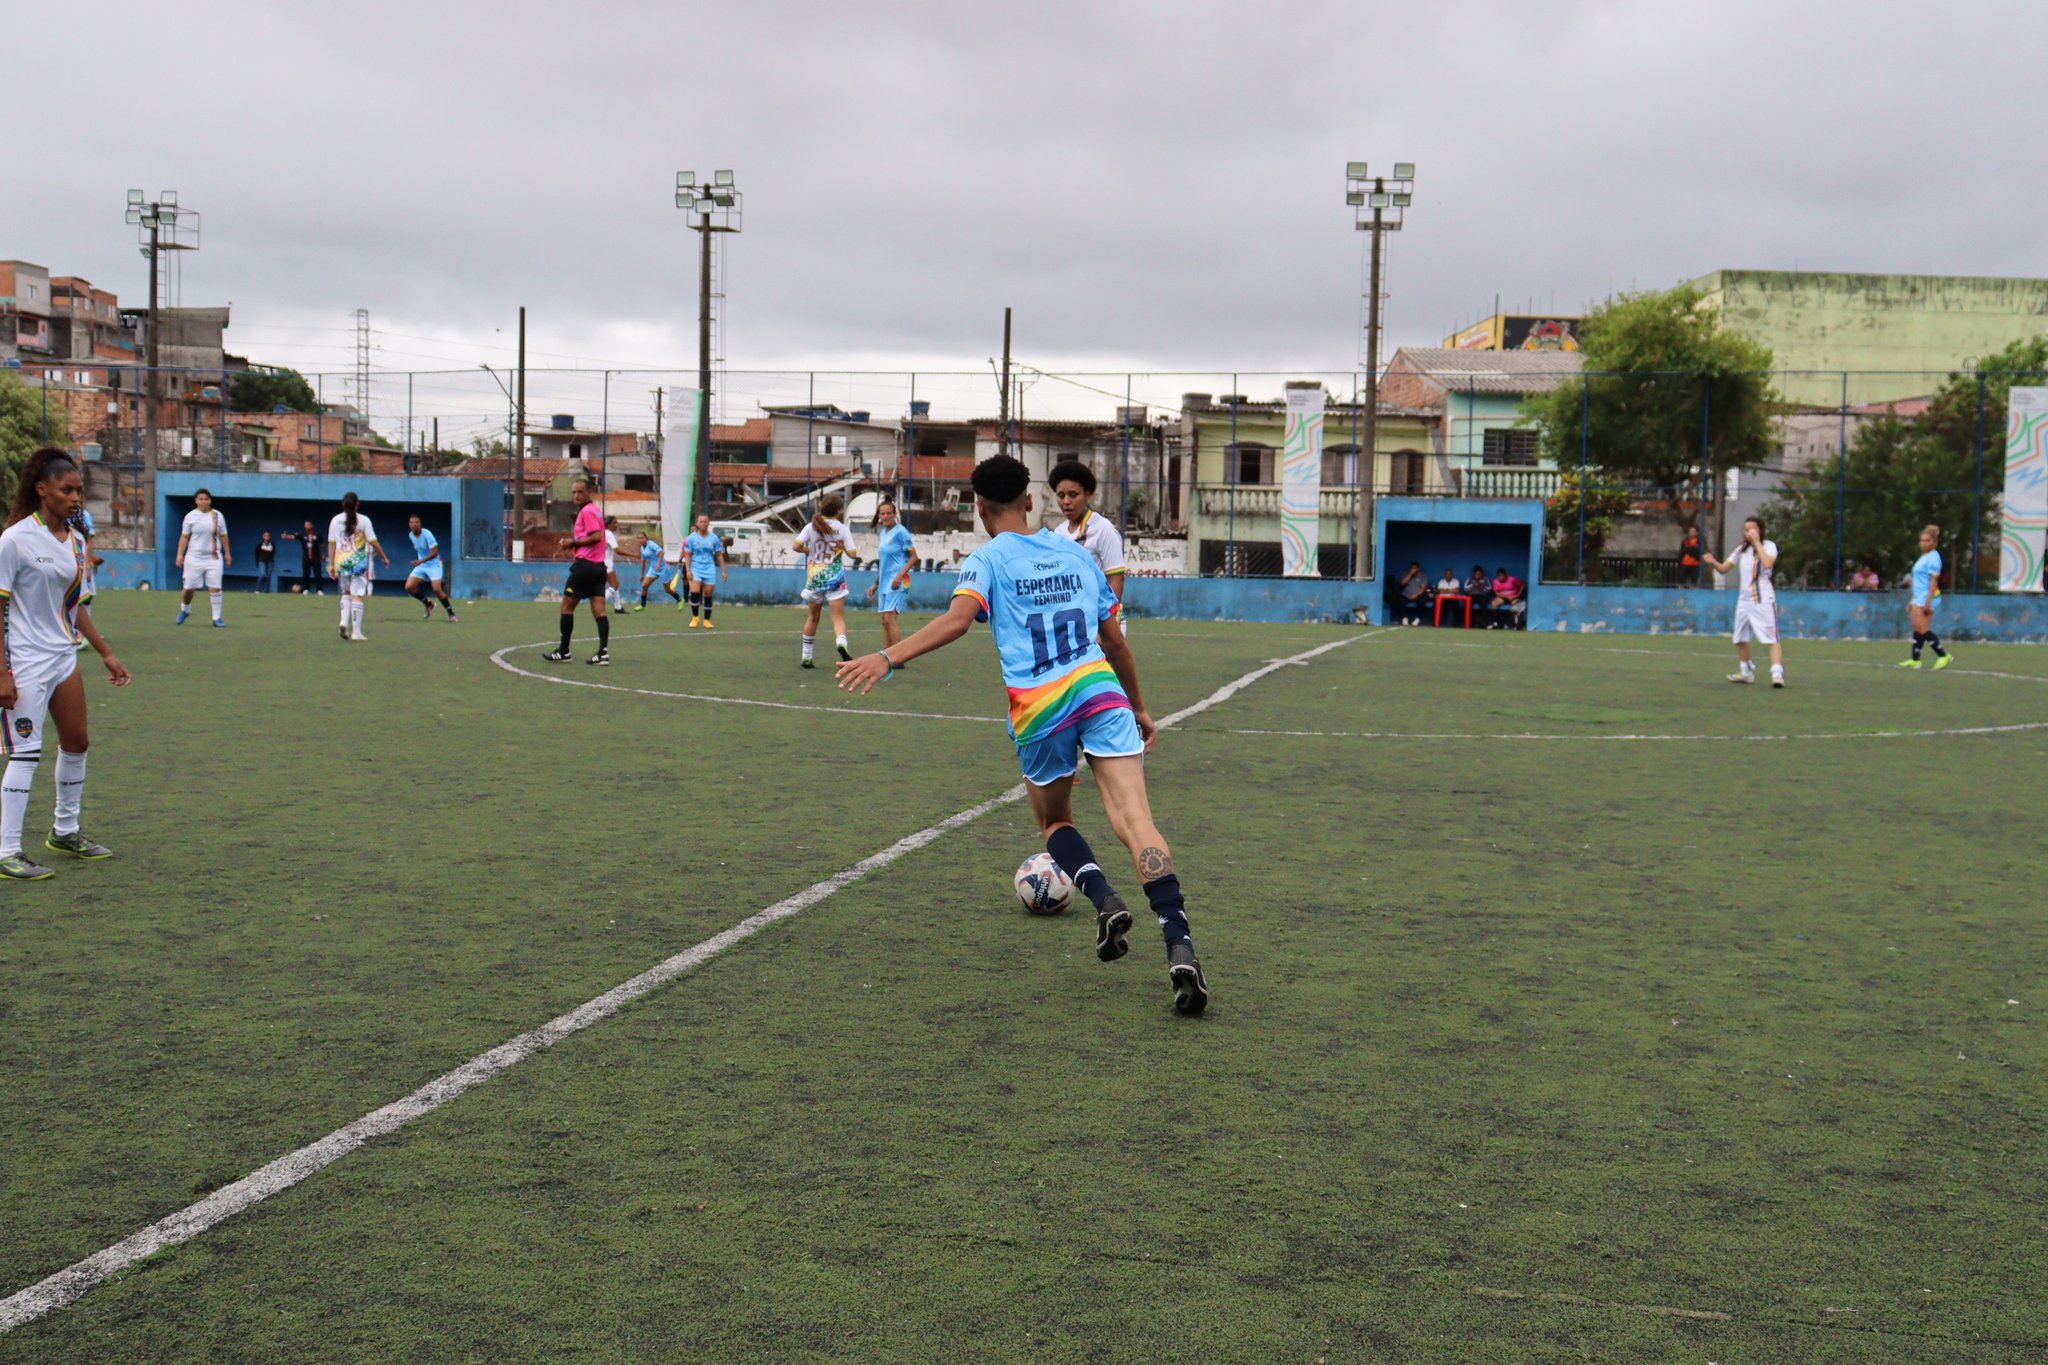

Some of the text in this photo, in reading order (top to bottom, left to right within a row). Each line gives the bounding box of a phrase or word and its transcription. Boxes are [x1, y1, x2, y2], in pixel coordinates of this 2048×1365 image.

[1015, 574, 1083, 596] ESPERANÇA
[1034, 592, 1072, 606] FEMININO
[1024, 608, 1091, 678] 10
[1034, 876, 1049, 905] uhlspo
